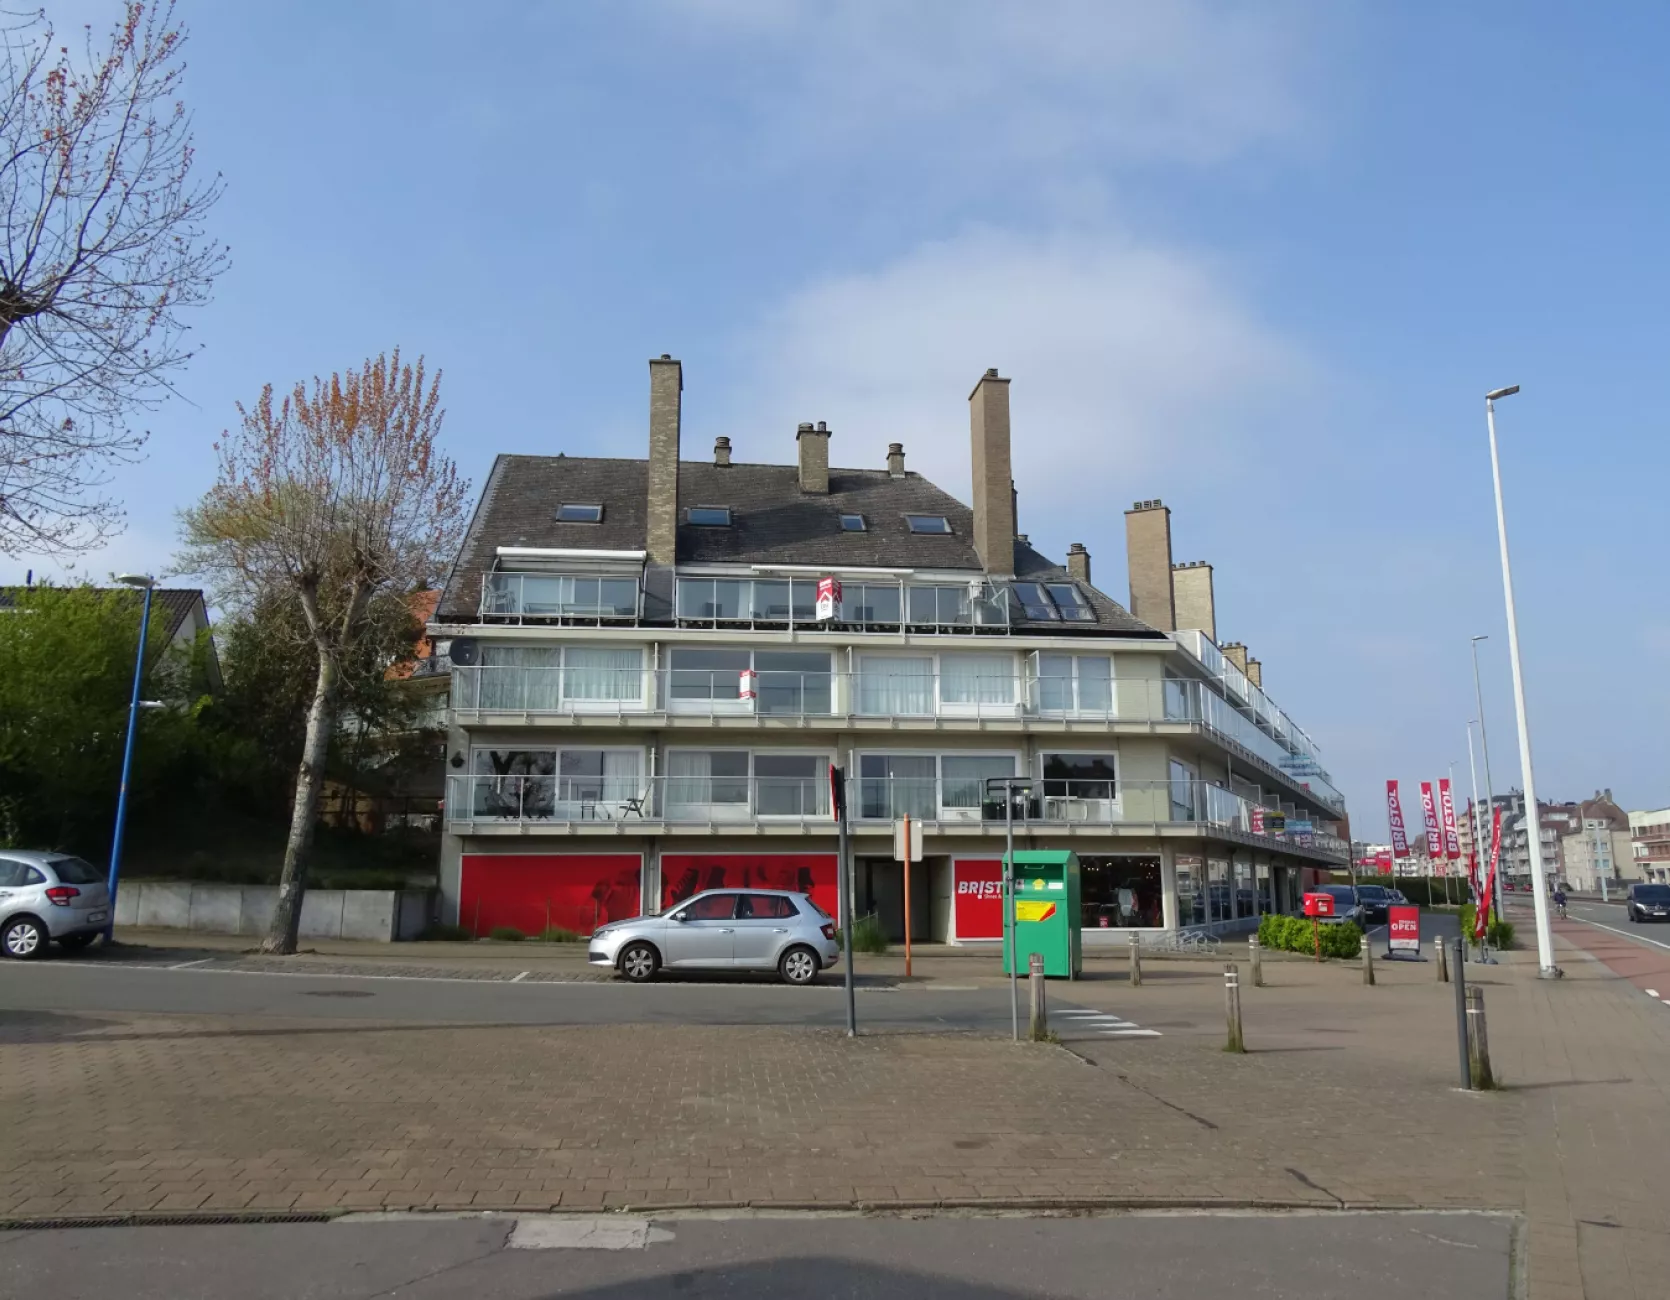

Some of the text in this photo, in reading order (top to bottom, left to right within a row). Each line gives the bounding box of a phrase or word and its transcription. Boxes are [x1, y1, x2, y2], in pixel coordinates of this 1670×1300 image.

[1388, 788, 1406, 851] BRISTOL
[1422, 790, 1440, 852] BRISTOL
[1441, 787, 1458, 852] BRISTOL
[958, 881, 1003, 898] BRIST
[1391, 922, 1417, 931] OPEN
